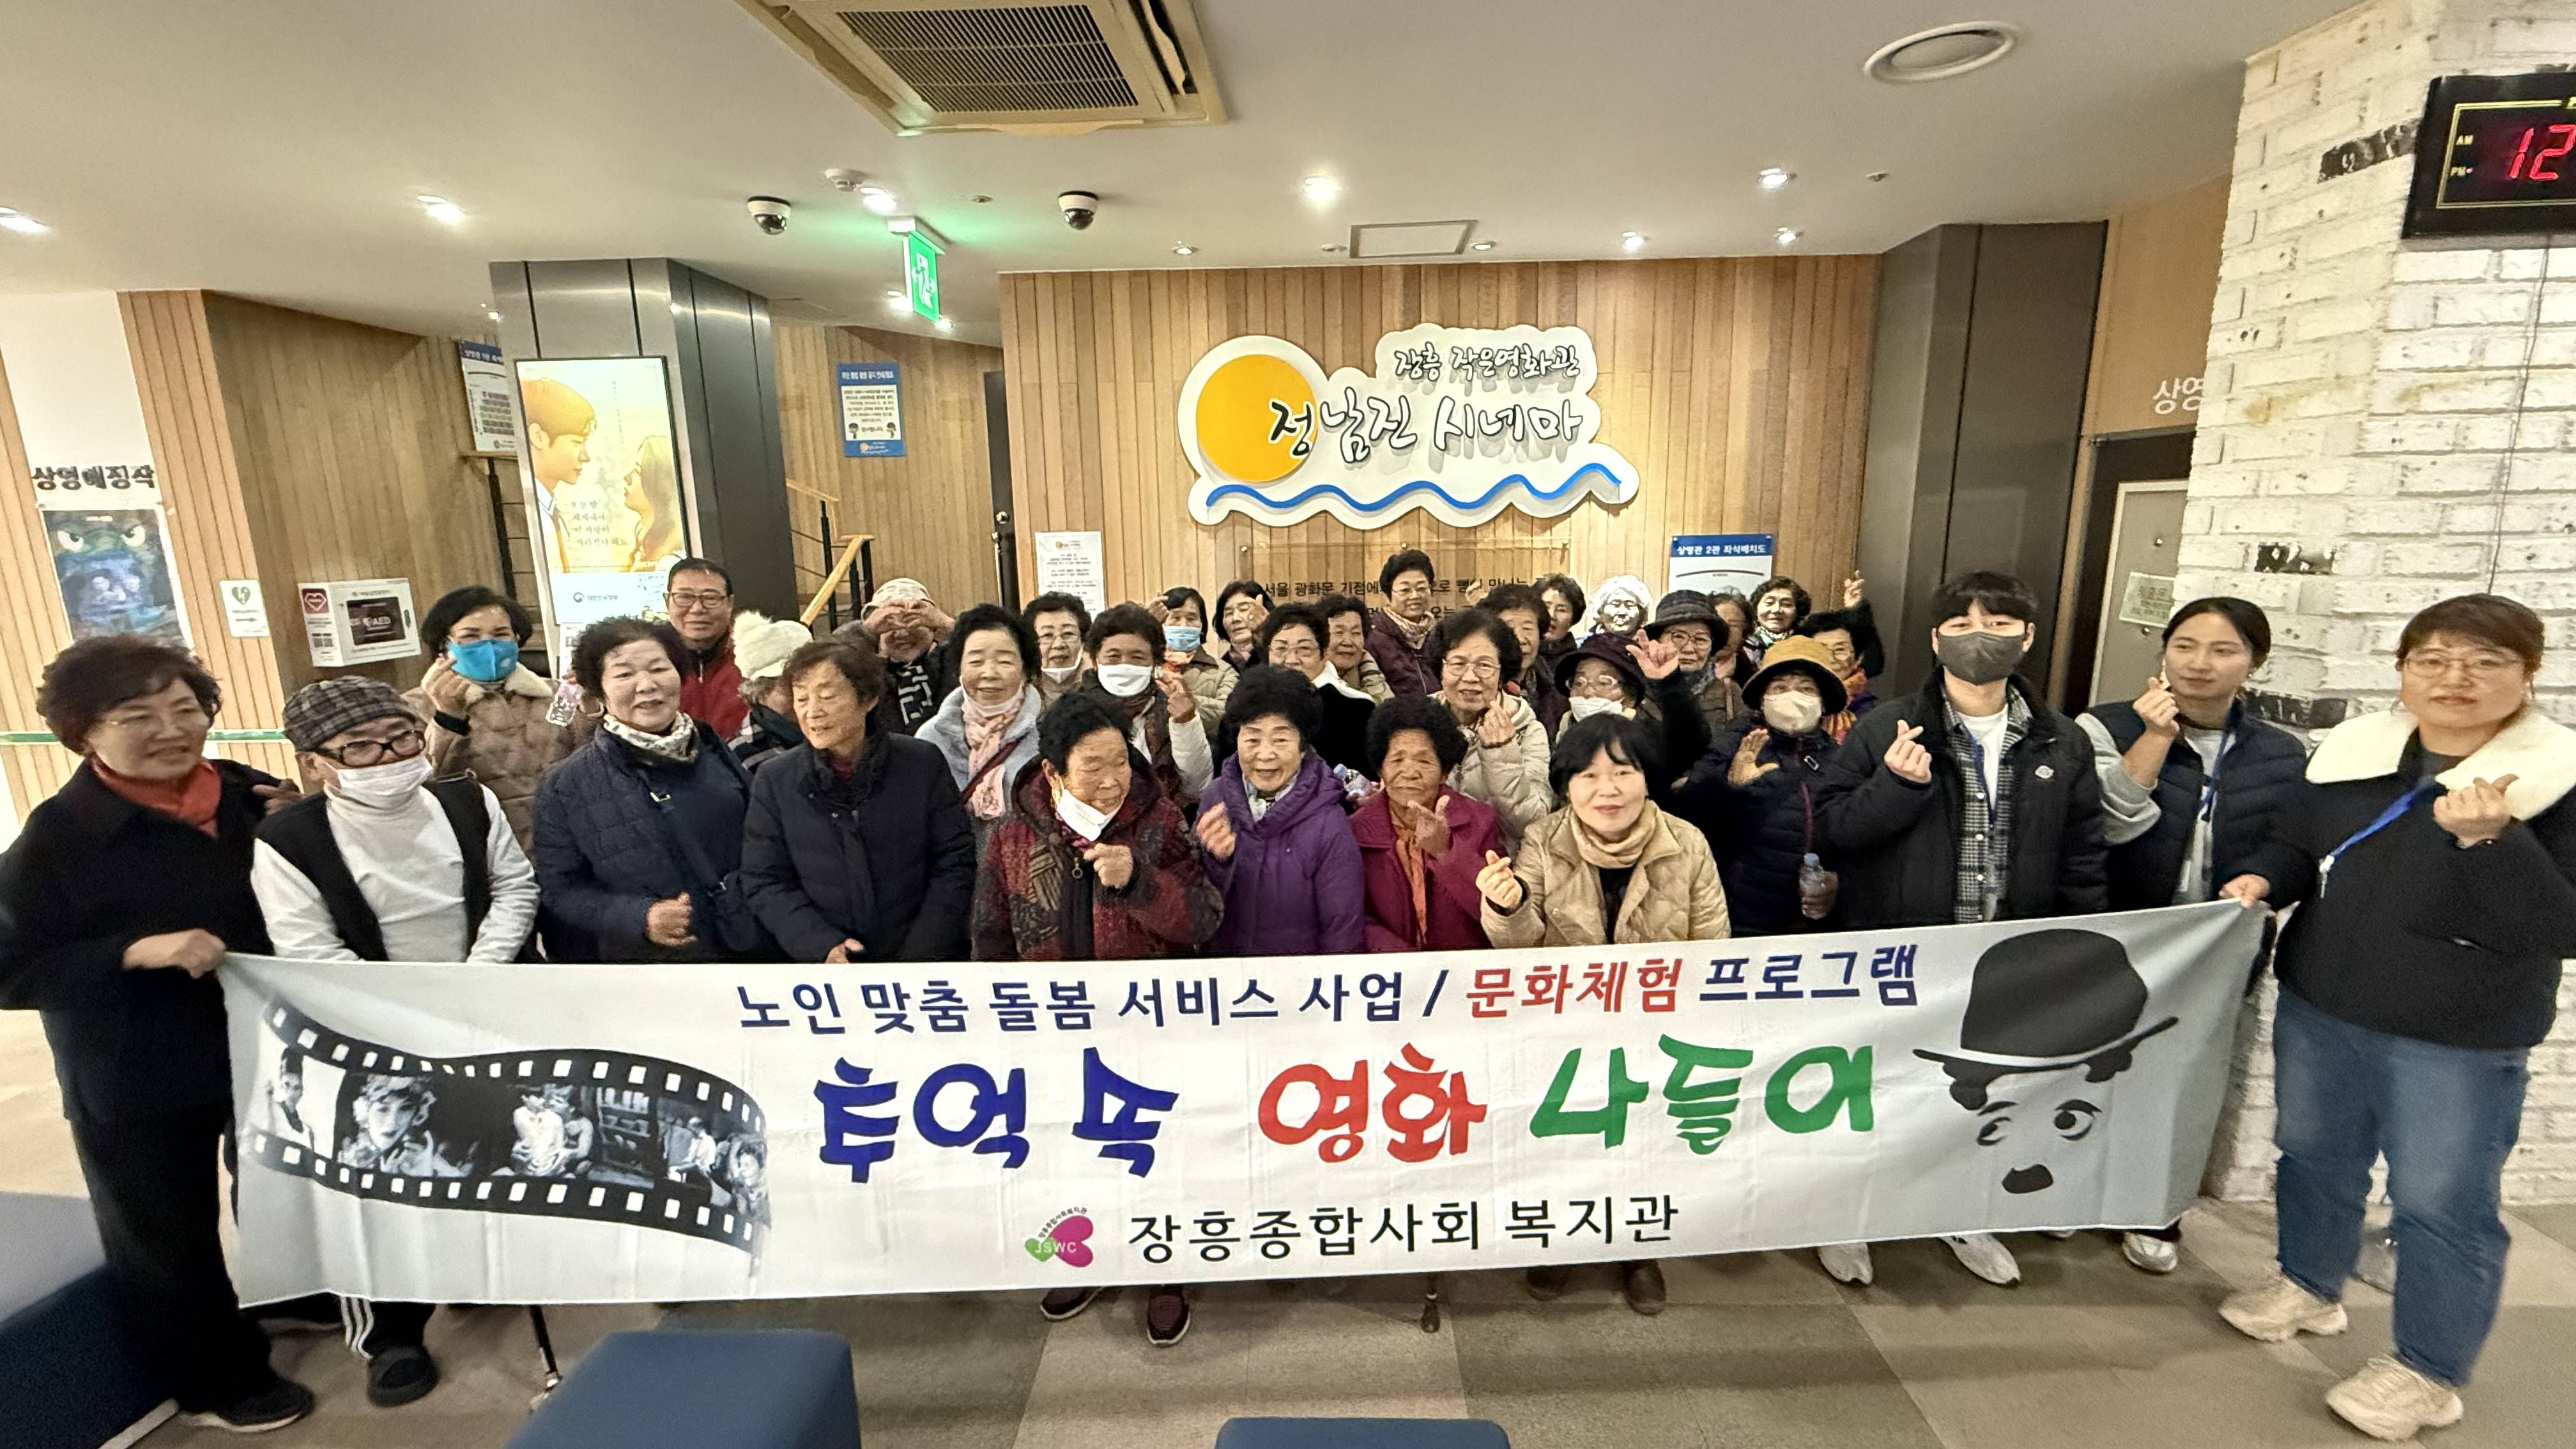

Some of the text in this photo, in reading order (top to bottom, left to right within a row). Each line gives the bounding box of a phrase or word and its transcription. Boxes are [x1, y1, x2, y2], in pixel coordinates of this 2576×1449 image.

[2456, 135, 2474, 145] AM
[2509, 124, 2576, 180] 12
[2450, 167, 2466, 177] PM
[1394, 341, 1581, 381] 장흥 작은영화관
[1269, 387, 1584, 464] 정남진 시네마
[1676, 544, 1767, 555] 상영관 2관 좌석배치도
[1266, 582, 1289, 597] 서울
[1341, 581, 1381, 595] 기점에
[738, 984, 845, 1034] 노인
[861, 981, 967, 1033] 맞춤
[990, 982, 1094, 1031] 돌봄
[1119, 978, 1278, 1026] 서비스
[1300, 973, 1401, 1021] 사업
[1467, 959, 1682, 1018] 문화체험
[1700, 945, 1917, 1005] 프로그램
[814, 1036, 1873, 1183] 추억 속 영화 나들이
[1034, 1241, 1077, 1254] JSWC
